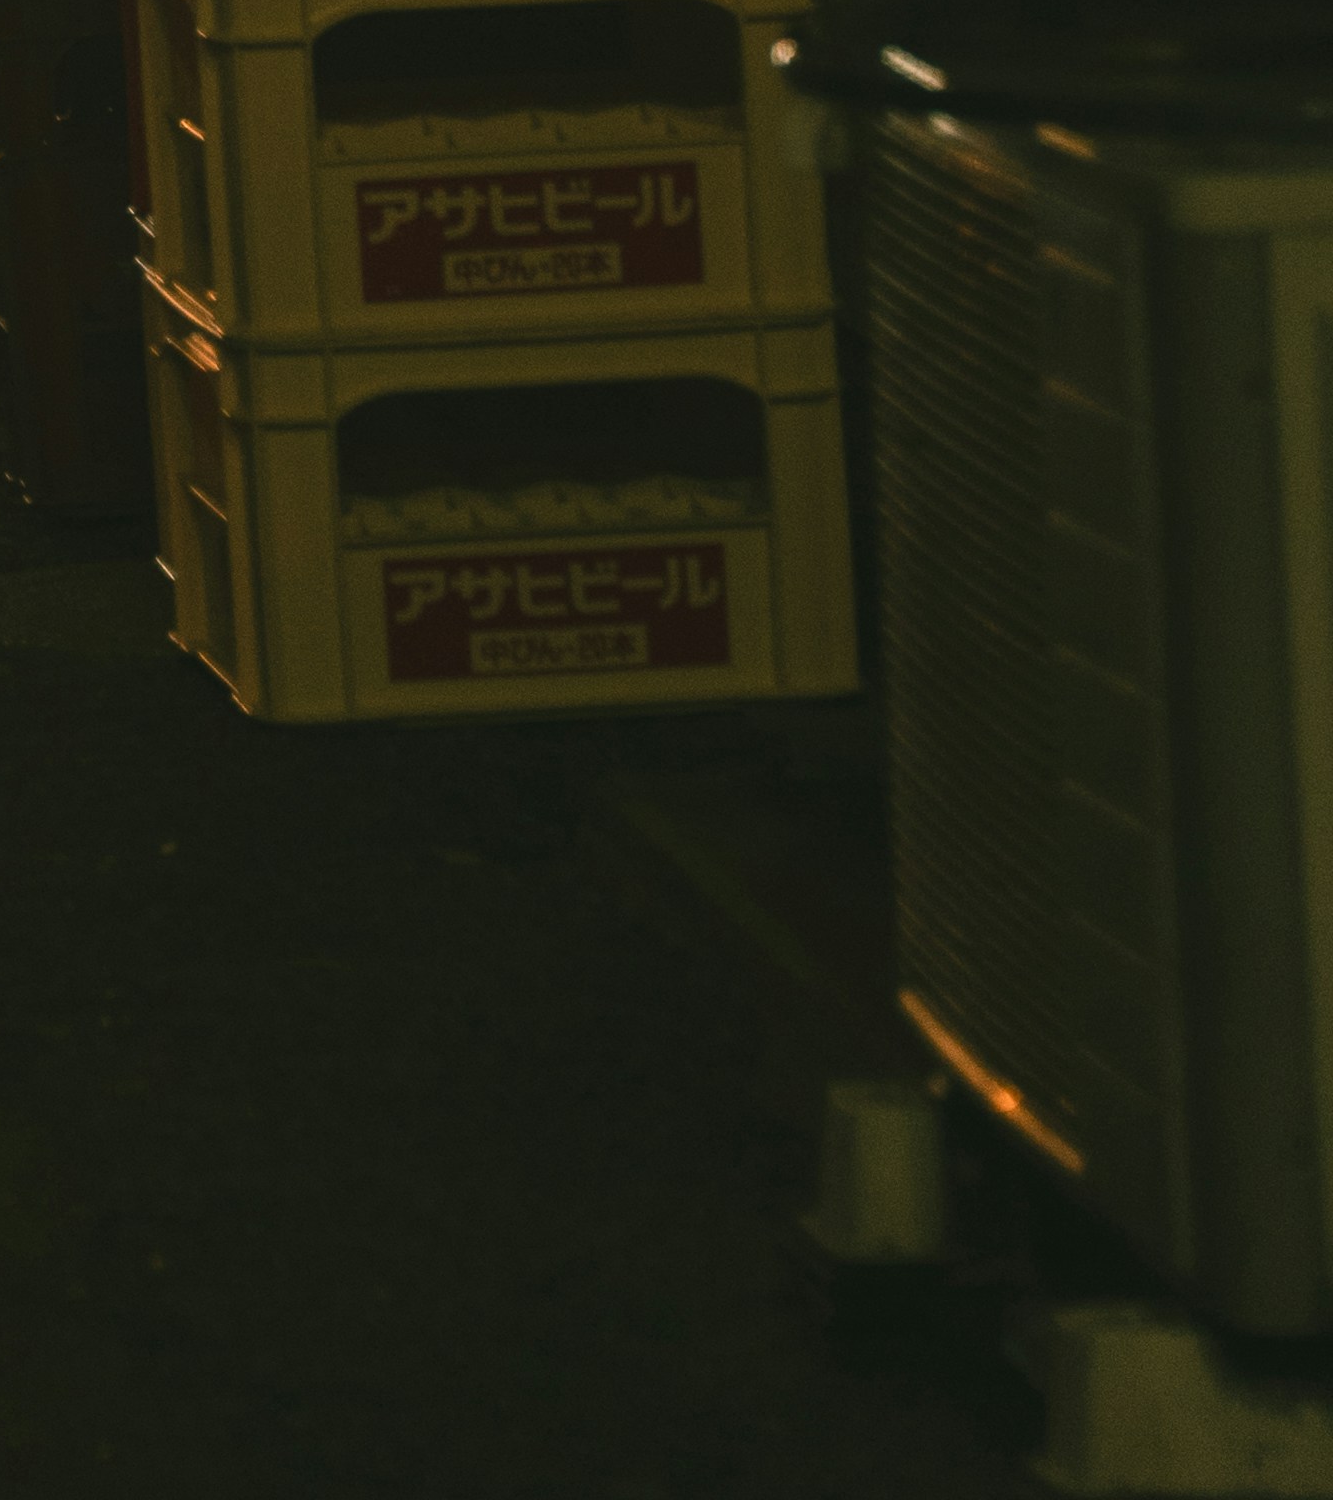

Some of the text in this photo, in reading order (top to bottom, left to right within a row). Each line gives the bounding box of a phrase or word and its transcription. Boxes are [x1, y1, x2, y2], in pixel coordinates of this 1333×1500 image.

[362, 172, 695, 246] アサヒビール
[389, 552, 721, 625] アサヒビール
